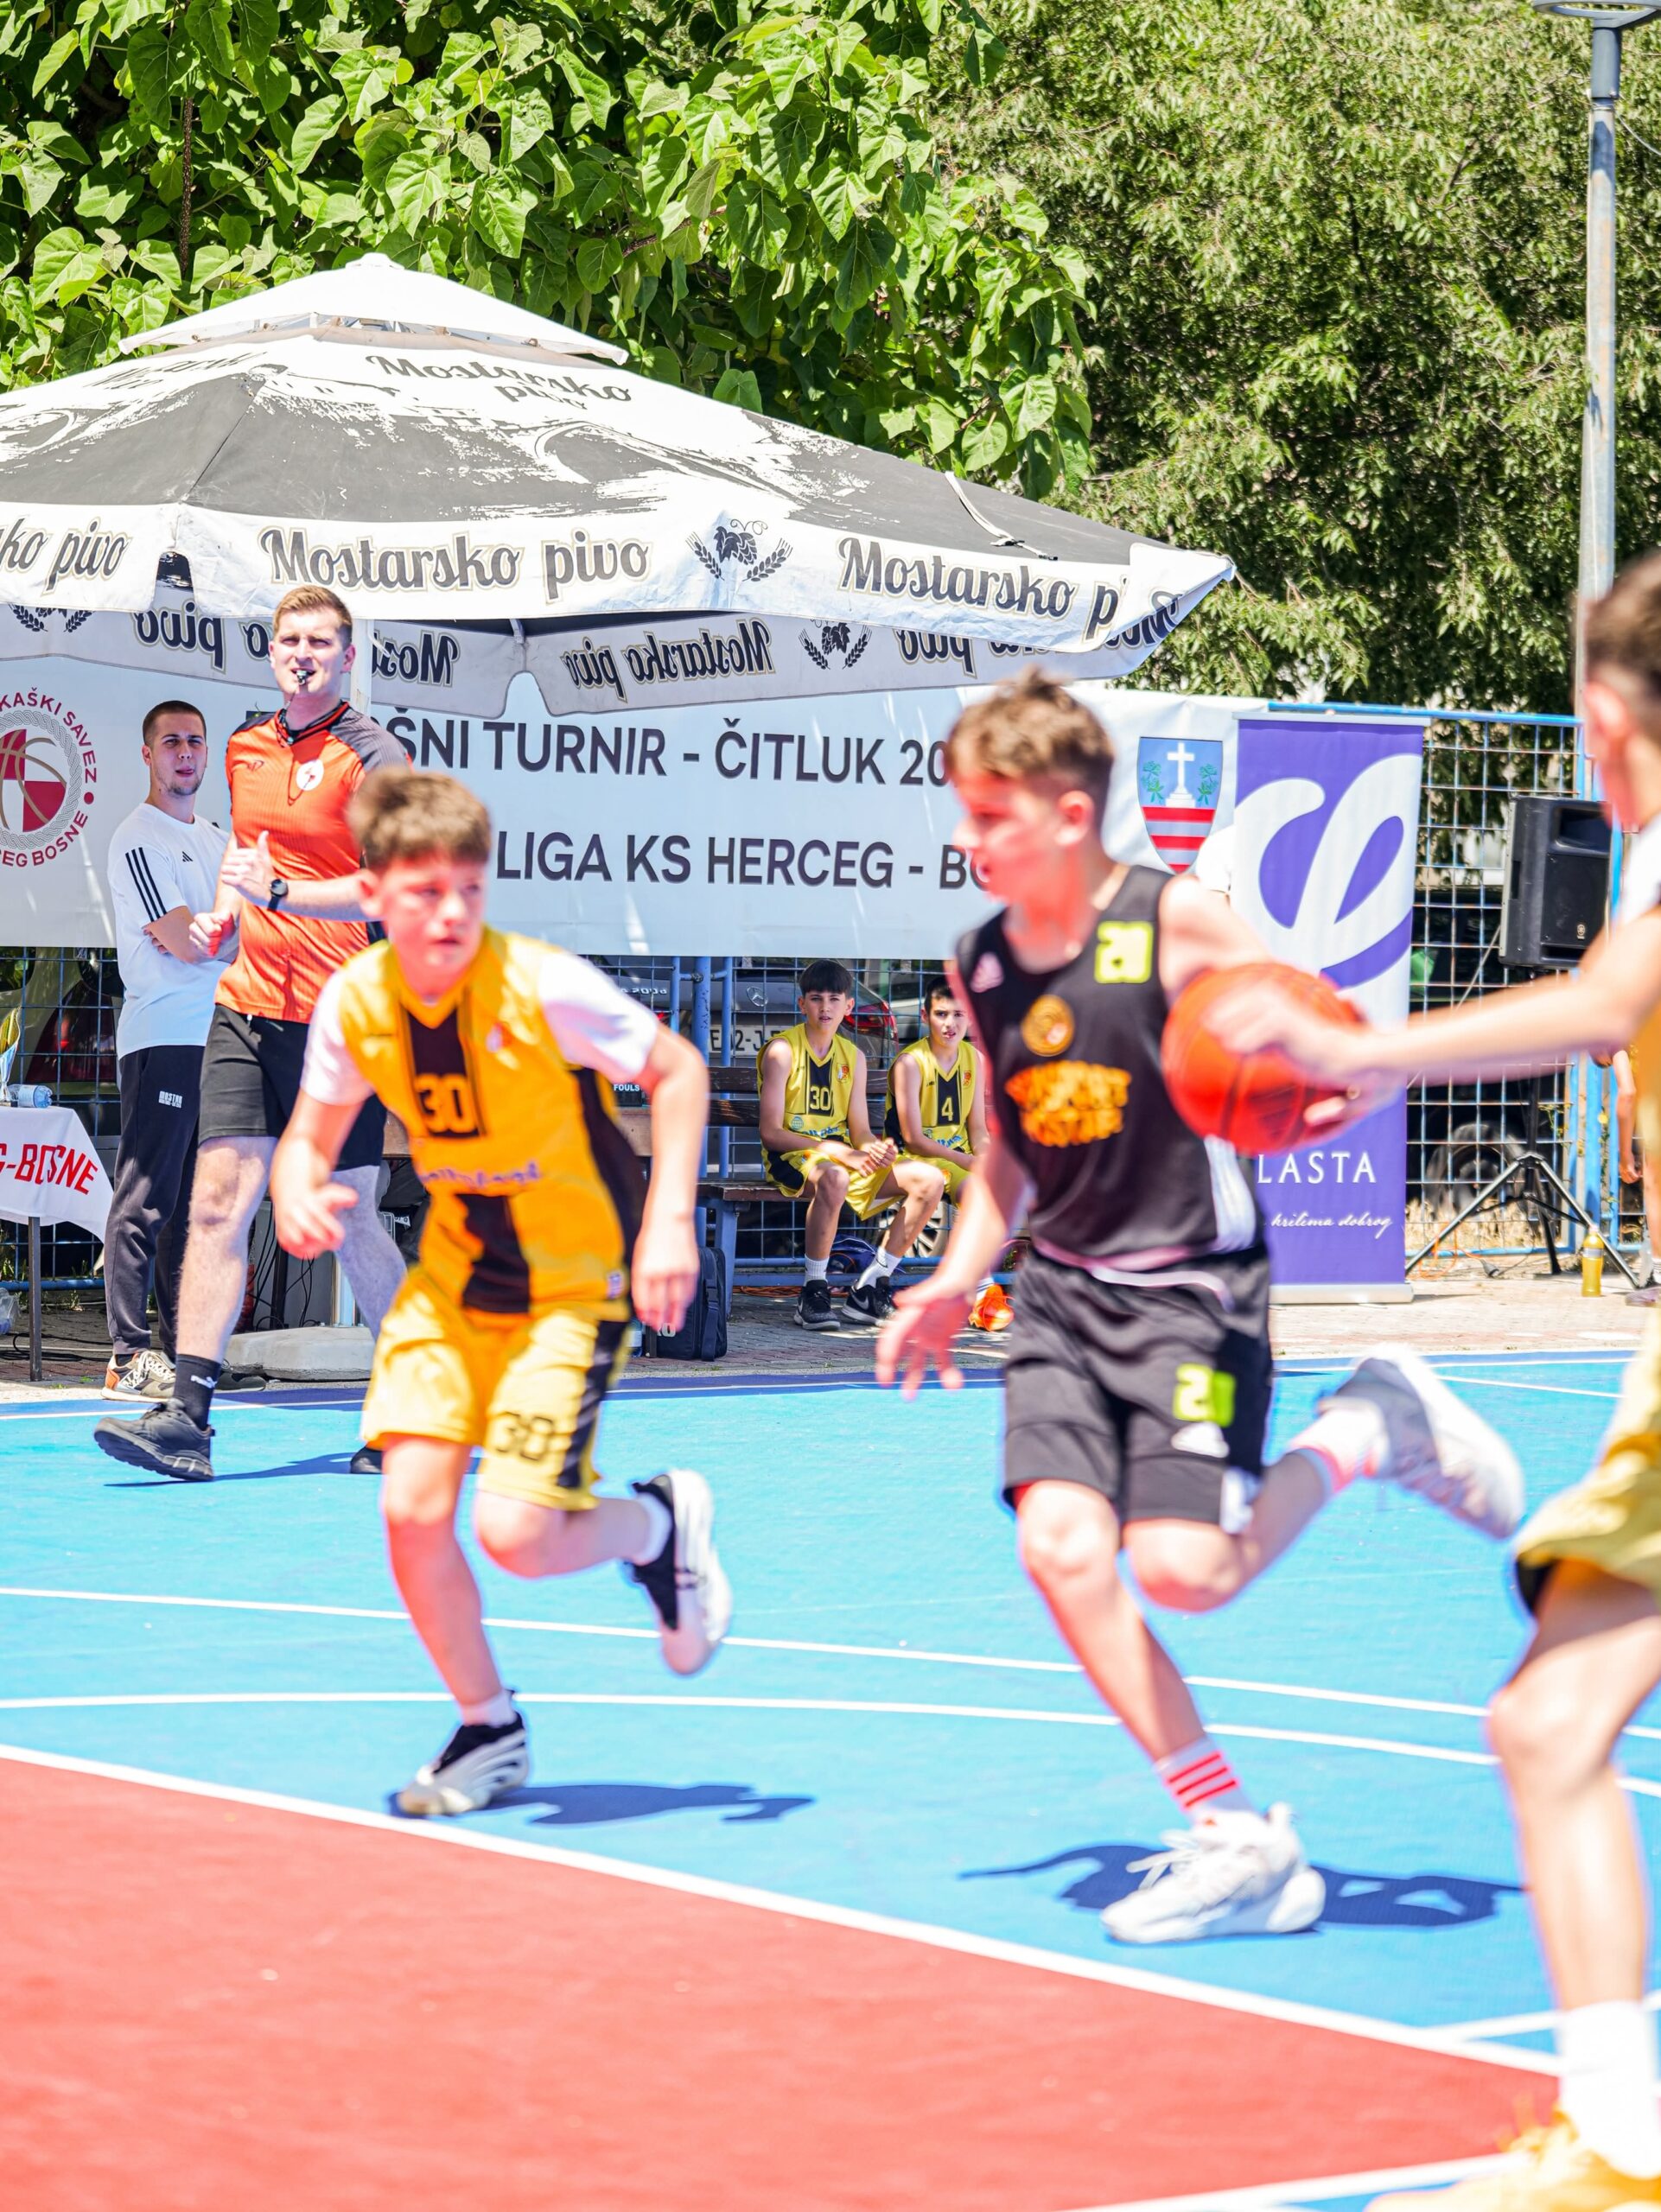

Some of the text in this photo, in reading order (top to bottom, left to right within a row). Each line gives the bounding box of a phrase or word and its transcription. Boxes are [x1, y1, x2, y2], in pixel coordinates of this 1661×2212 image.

[366, 355, 632, 402] Mostarsko
[0, 518, 129, 591] ko pivo
[262, 525, 649, 601] Mostarsko pivo
[838, 537, 1076, 619] Mostarsko
[0, 686, 97, 784] KAŠKI SAVEZ
[483, 721, 667, 776] TURNIR
[716, 717, 886, 785] ČITLUK
[900, 740, 951, 787] 20
[31, 810, 88, 866] BOSNE
[497, 831, 614, 881] LIGA
[627, 835, 690, 883] KS
[708, 836, 894, 888] HERCEG
[414, 1074, 479, 1135] 30
[614, 1084, 640, 1092] FOULS
[810, 1085, 831, 1110] 30
[941, 1096, 954, 1122] 4
[1257, 1152, 1377, 1184] LASTA
[1337, 1211, 1393, 1239] dobrog
